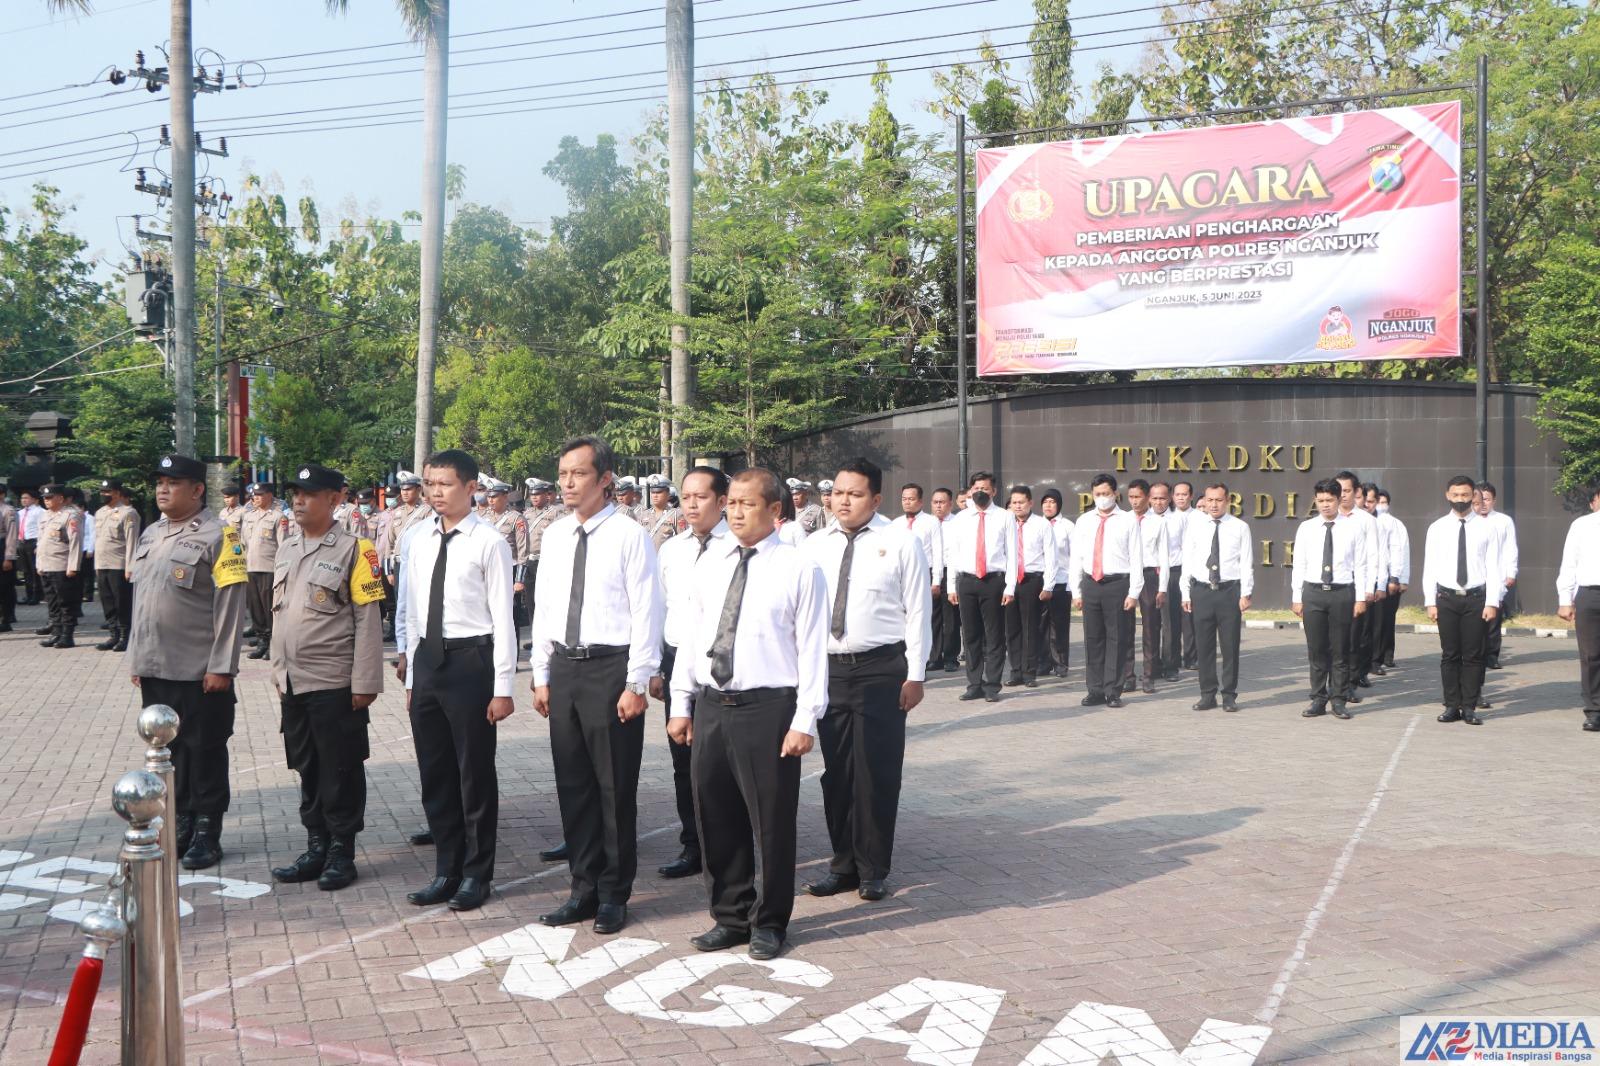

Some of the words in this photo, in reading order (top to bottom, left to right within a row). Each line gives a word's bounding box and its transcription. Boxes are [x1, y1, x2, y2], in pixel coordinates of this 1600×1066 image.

[1083, 162, 1331, 217] UPACARA
[1075, 224, 1191, 246] PEMBERIAAN
[1195, 213, 1340, 236] PENGHARGAAN
[1044, 254, 1114, 270] KEPADA
[1118, 246, 1206, 265] ANGGOTA
[1208, 240, 1281, 259] POLRES
[1284, 232, 1379, 254] NGANJUK
[1118, 271, 1166, 286] YANG
[1171, 262, 1293, 283] BERPRESTASI
[1146, 294, 1199, 304] NGANJUK,
[1202, 293, 1208, 301] 5
[1211, 291, 1235, 300] JUNI
[1237, 290, 1262, 299] 2023
[1370, 319, 1435, 337] NGANJUK
[1111, 444, 1315, 471] TEKADKU
[178, 541, 203, 551] POLRI
[318, 561, 342, 574] POLRI
